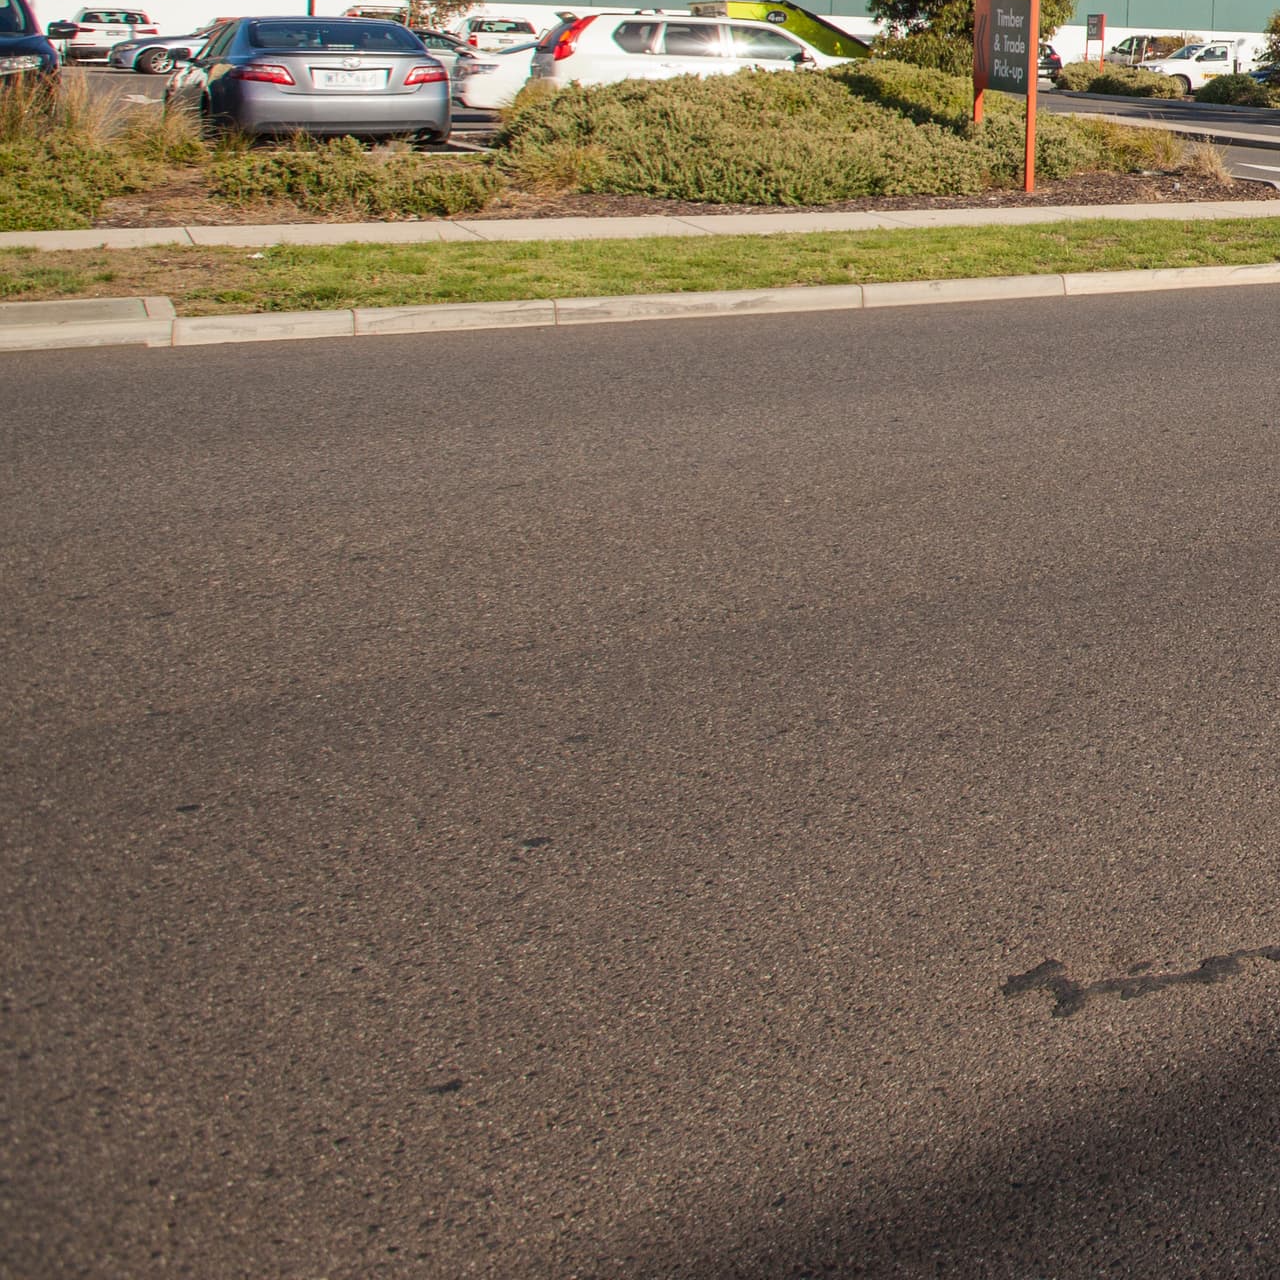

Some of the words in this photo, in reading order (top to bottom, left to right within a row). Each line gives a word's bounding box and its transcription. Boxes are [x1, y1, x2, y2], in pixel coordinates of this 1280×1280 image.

[996, 7, 1024, 28] Timber
[993, 33, 1000, 52] &
[1003, 34, 1026, 54] Trade
[993, 58, 1024, 83] Pick-up
